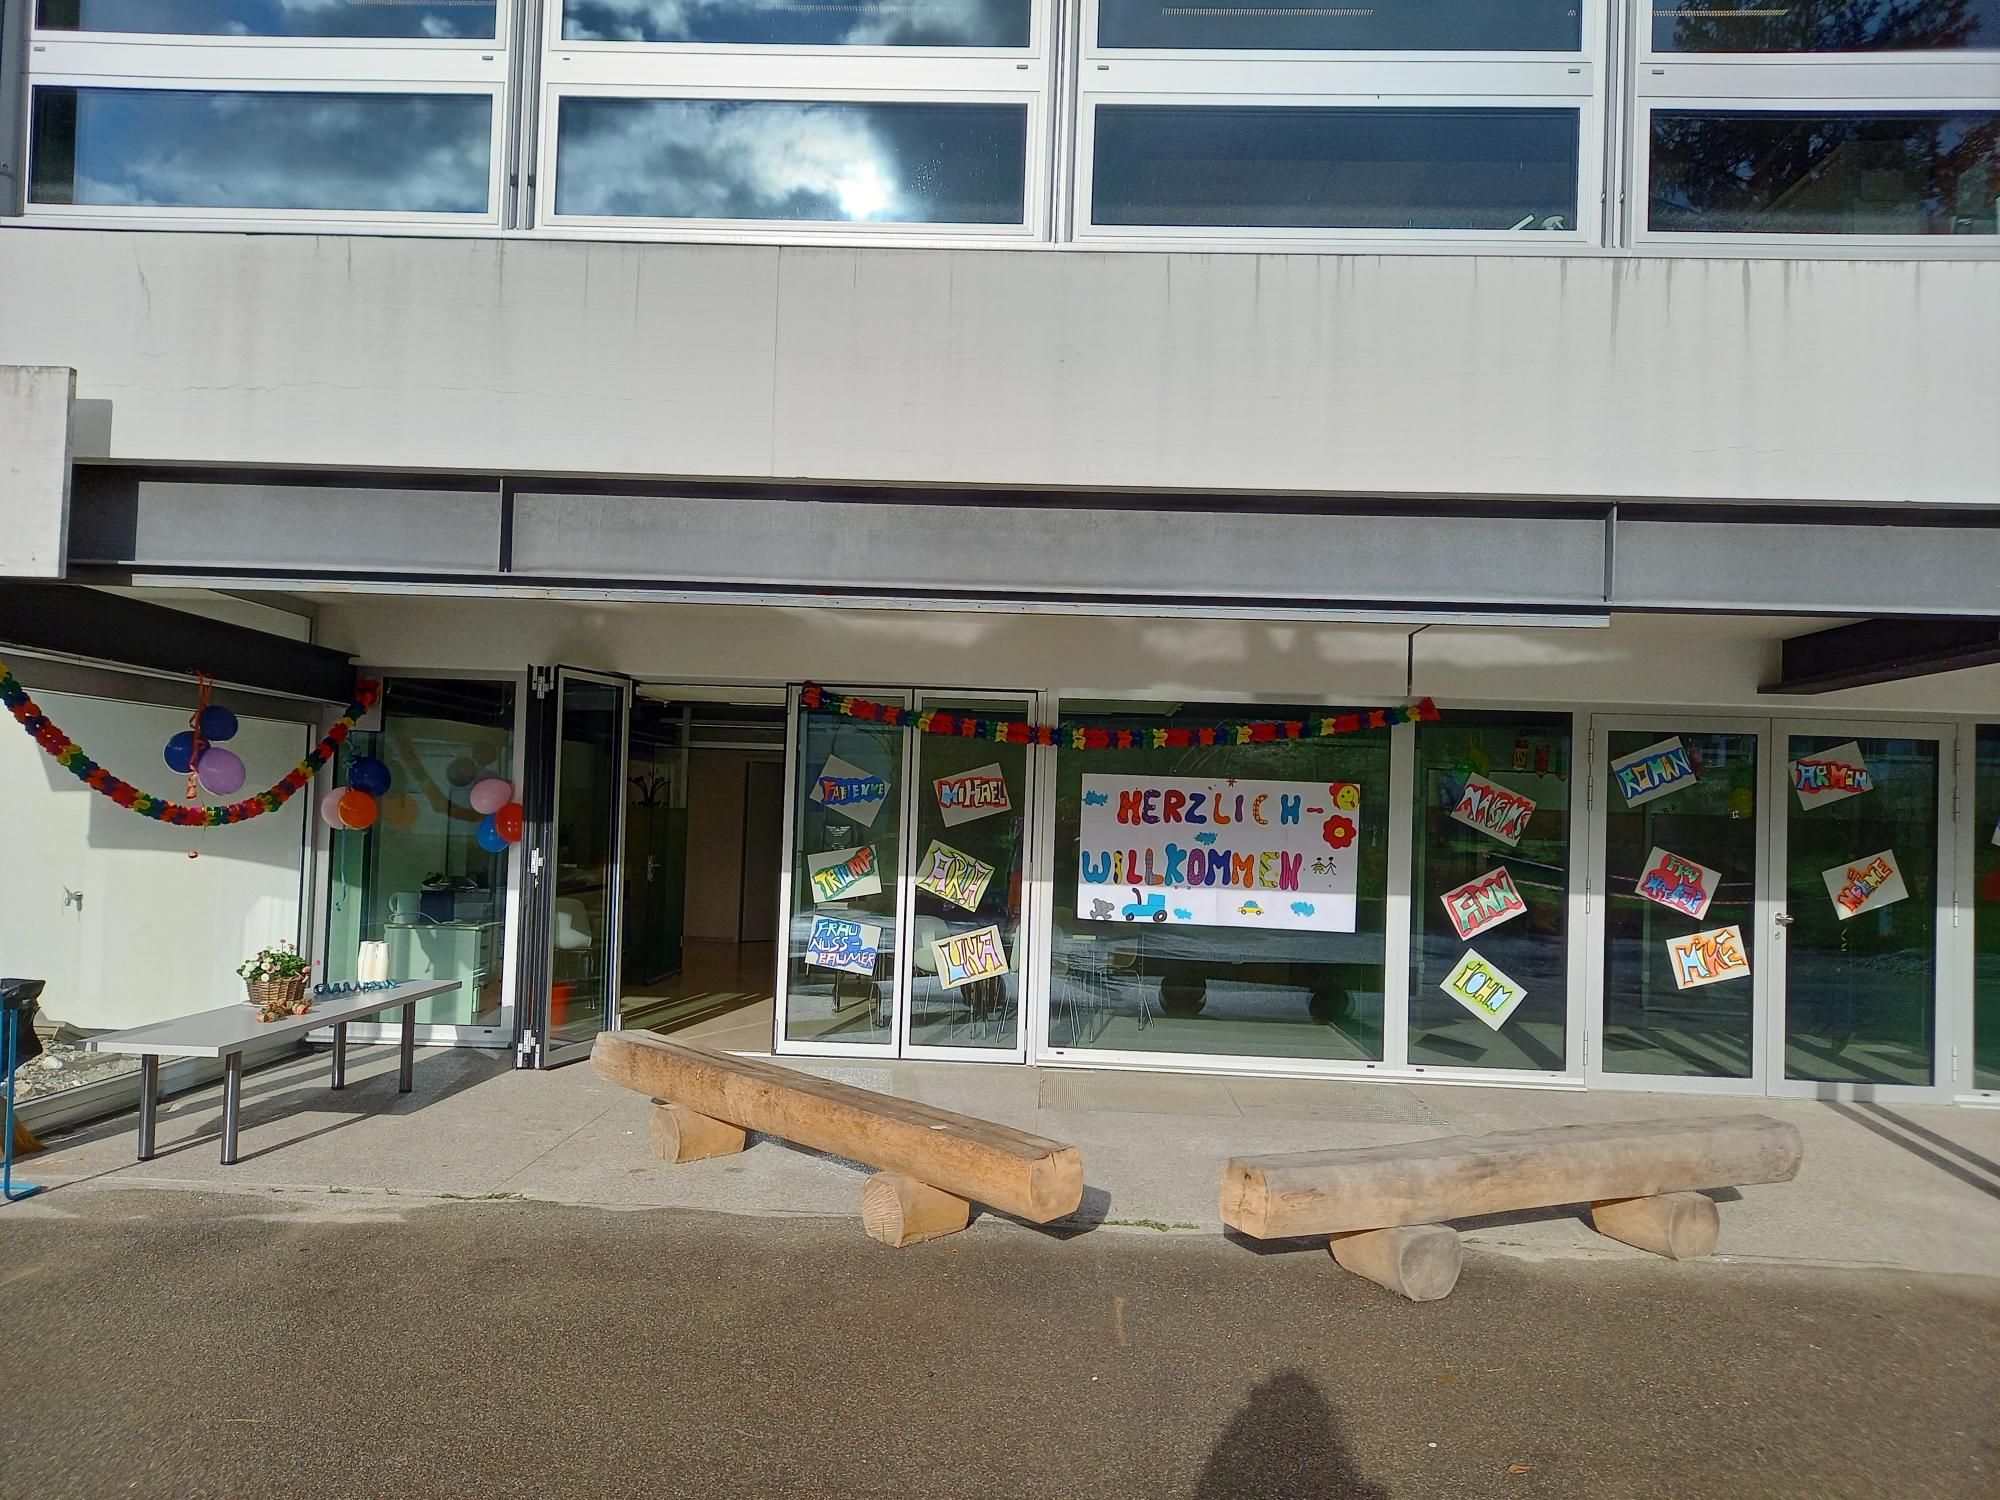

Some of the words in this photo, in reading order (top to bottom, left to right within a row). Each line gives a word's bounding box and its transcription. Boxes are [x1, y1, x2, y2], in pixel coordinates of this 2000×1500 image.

[1618, 748, 1694, 799] ROMAN
[1795, 762, 1869, 791] ARMIN
[1116, 788, 1325, 826] HERZLICH-
[811, 847, 875, 899] TRIUMF
[1081, 842, 1303, 892] WILLKOMMEN
[1450, 875, 1518, 933] FINN
[815, 919, 859, 938] FRAU
[818, 951, 877, 968] BAUMER
